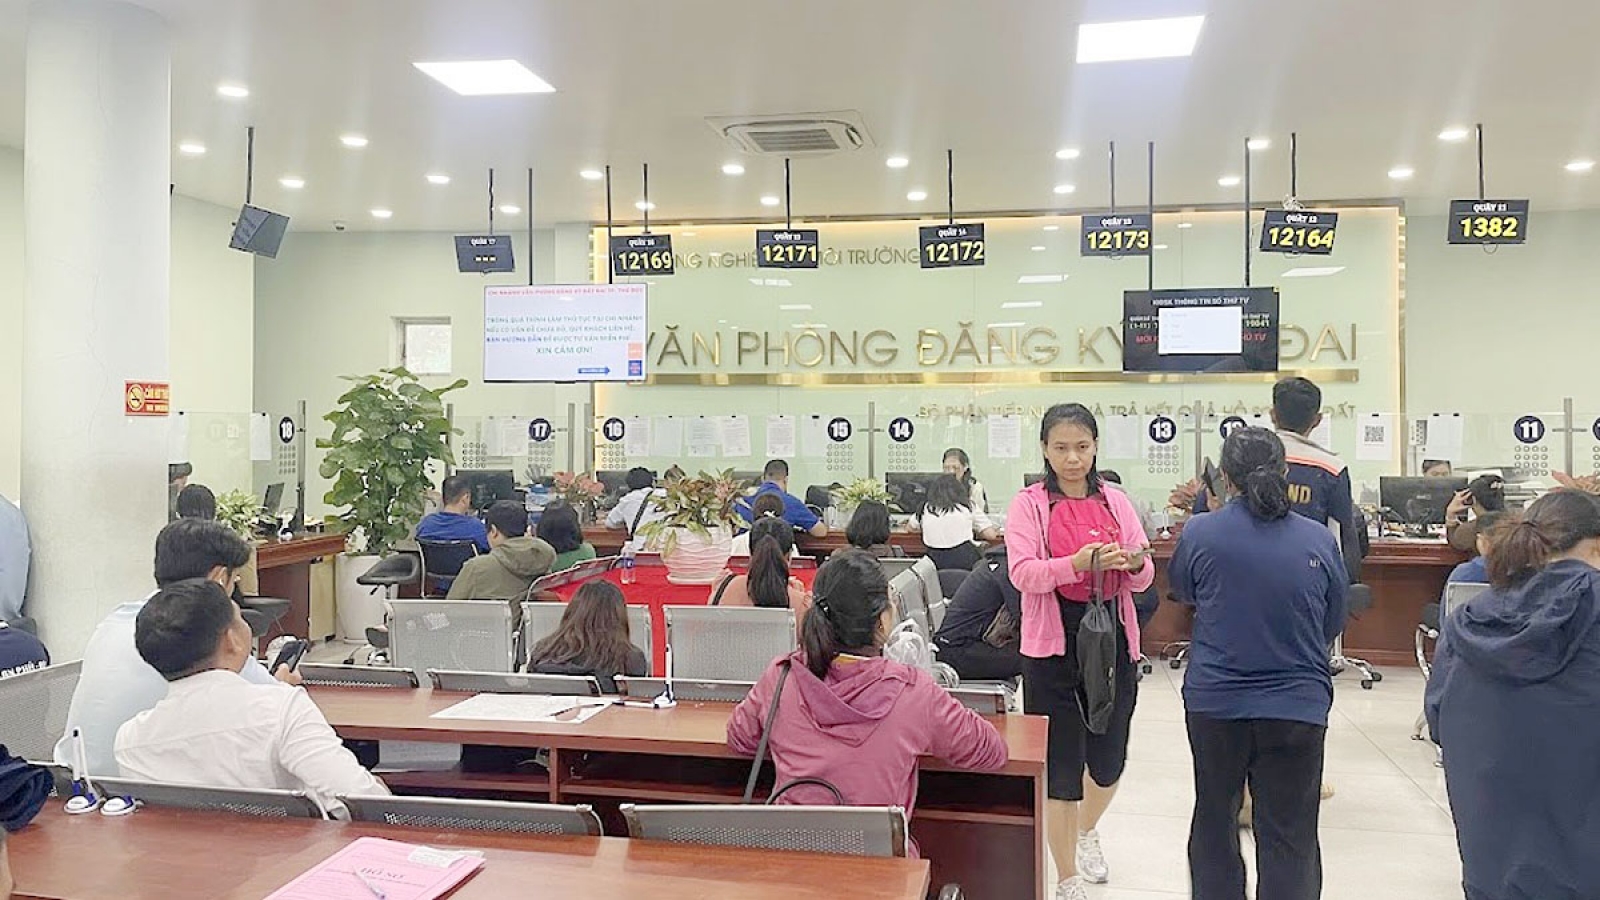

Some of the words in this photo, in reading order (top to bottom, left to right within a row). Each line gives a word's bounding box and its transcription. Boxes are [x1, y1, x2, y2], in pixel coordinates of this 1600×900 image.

[1460, 216, 1518, 237] 1382
[1087, 231, 1150, 249] 12173
[1268, 227, 1336, 249] 12164
[618, 251, 673, 270] 12169
[762, 245, 817, 262] 12171
[925, 241, 985, 262] 12172
[675, 252, 702, 270] NG
[738, 321, 898, 367] PHÒNG
[917, 320, 1060, 366] ĐĂNG
[281, 421, 293, 438] 18
[533, 421, 547, 438] 17
[606, 421, 624, 438] 16
[830, 419, 849, 437] 15
[892, 420, 911, 438] 14
[1152, 421, 1172, 438] 13
[1520, 421, 1538, 438] 11
[1287, 483, 1312, 504] ND
